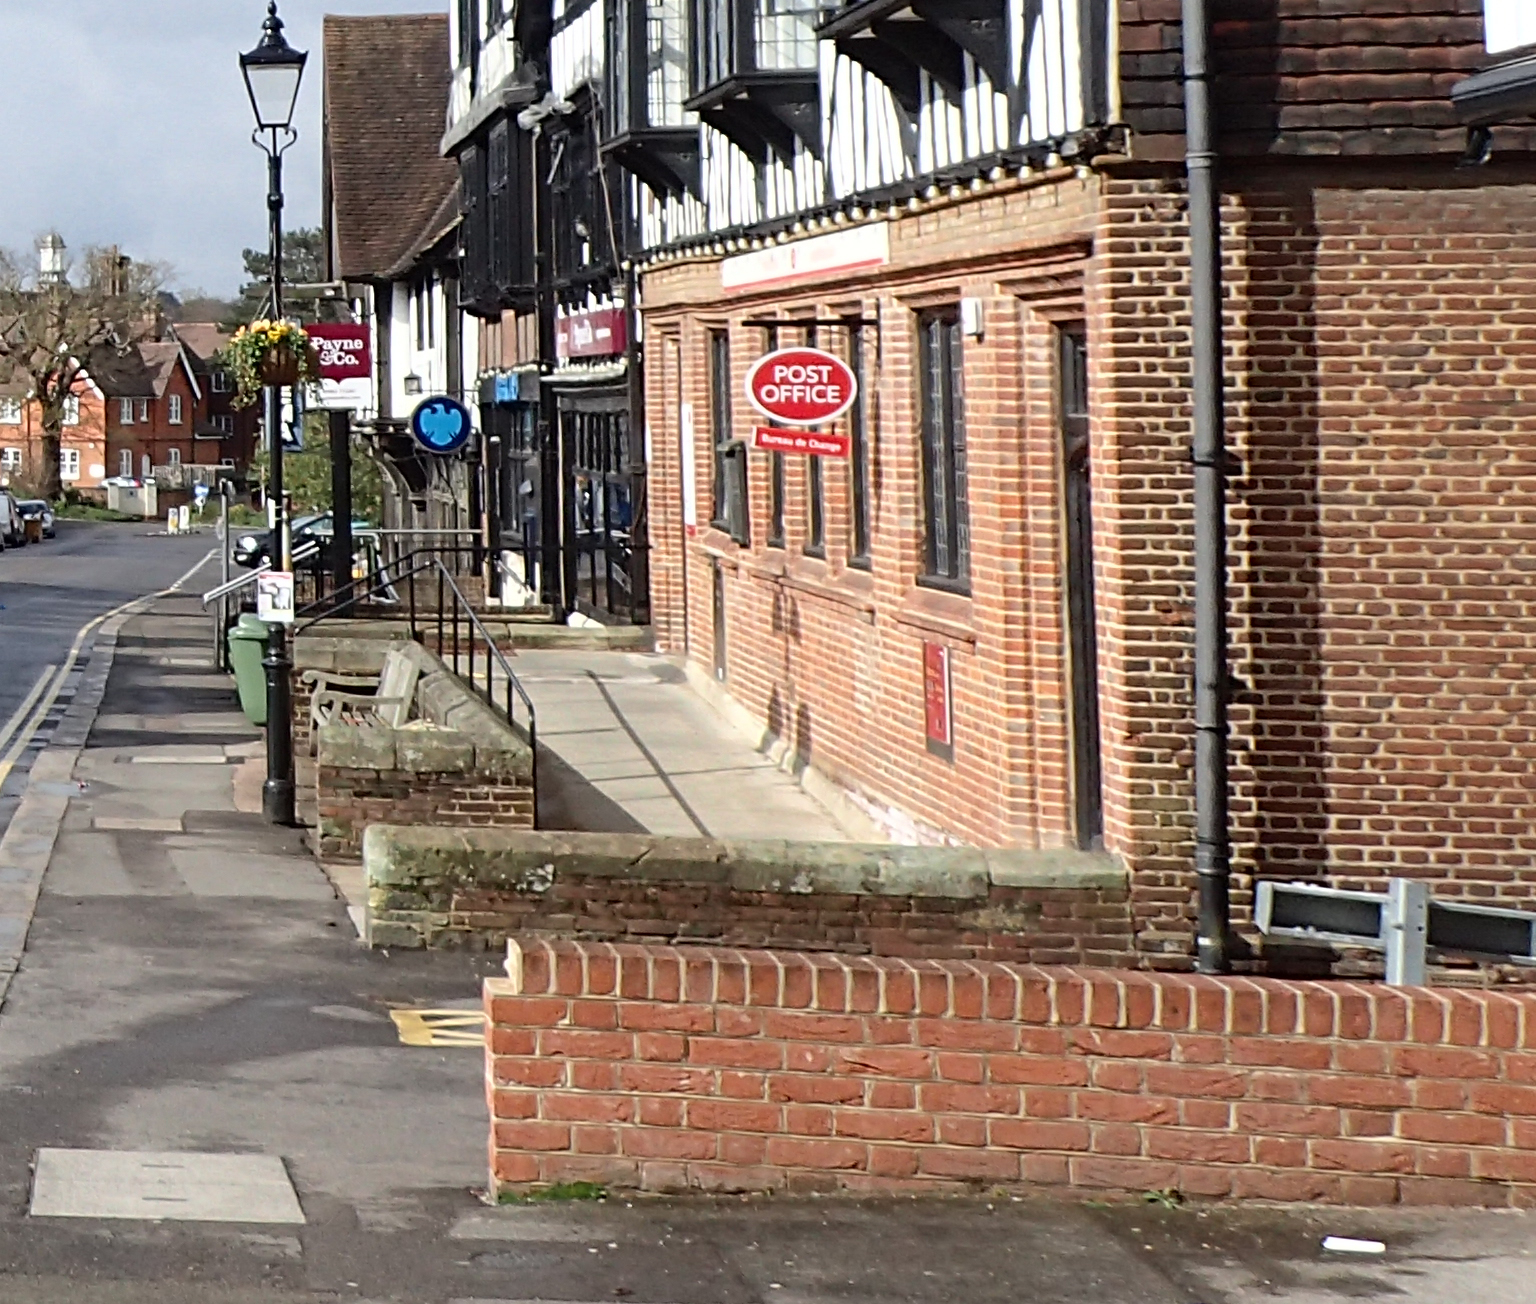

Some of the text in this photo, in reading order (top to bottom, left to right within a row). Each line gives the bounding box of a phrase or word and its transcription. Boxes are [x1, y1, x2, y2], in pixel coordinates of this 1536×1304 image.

[310, 336, 364, 353] Payne
[773, 365, 833, 384] POST
[760, 384, 842, 404] OFFICE
[761, 433, 842, 453] Bureau de Change
